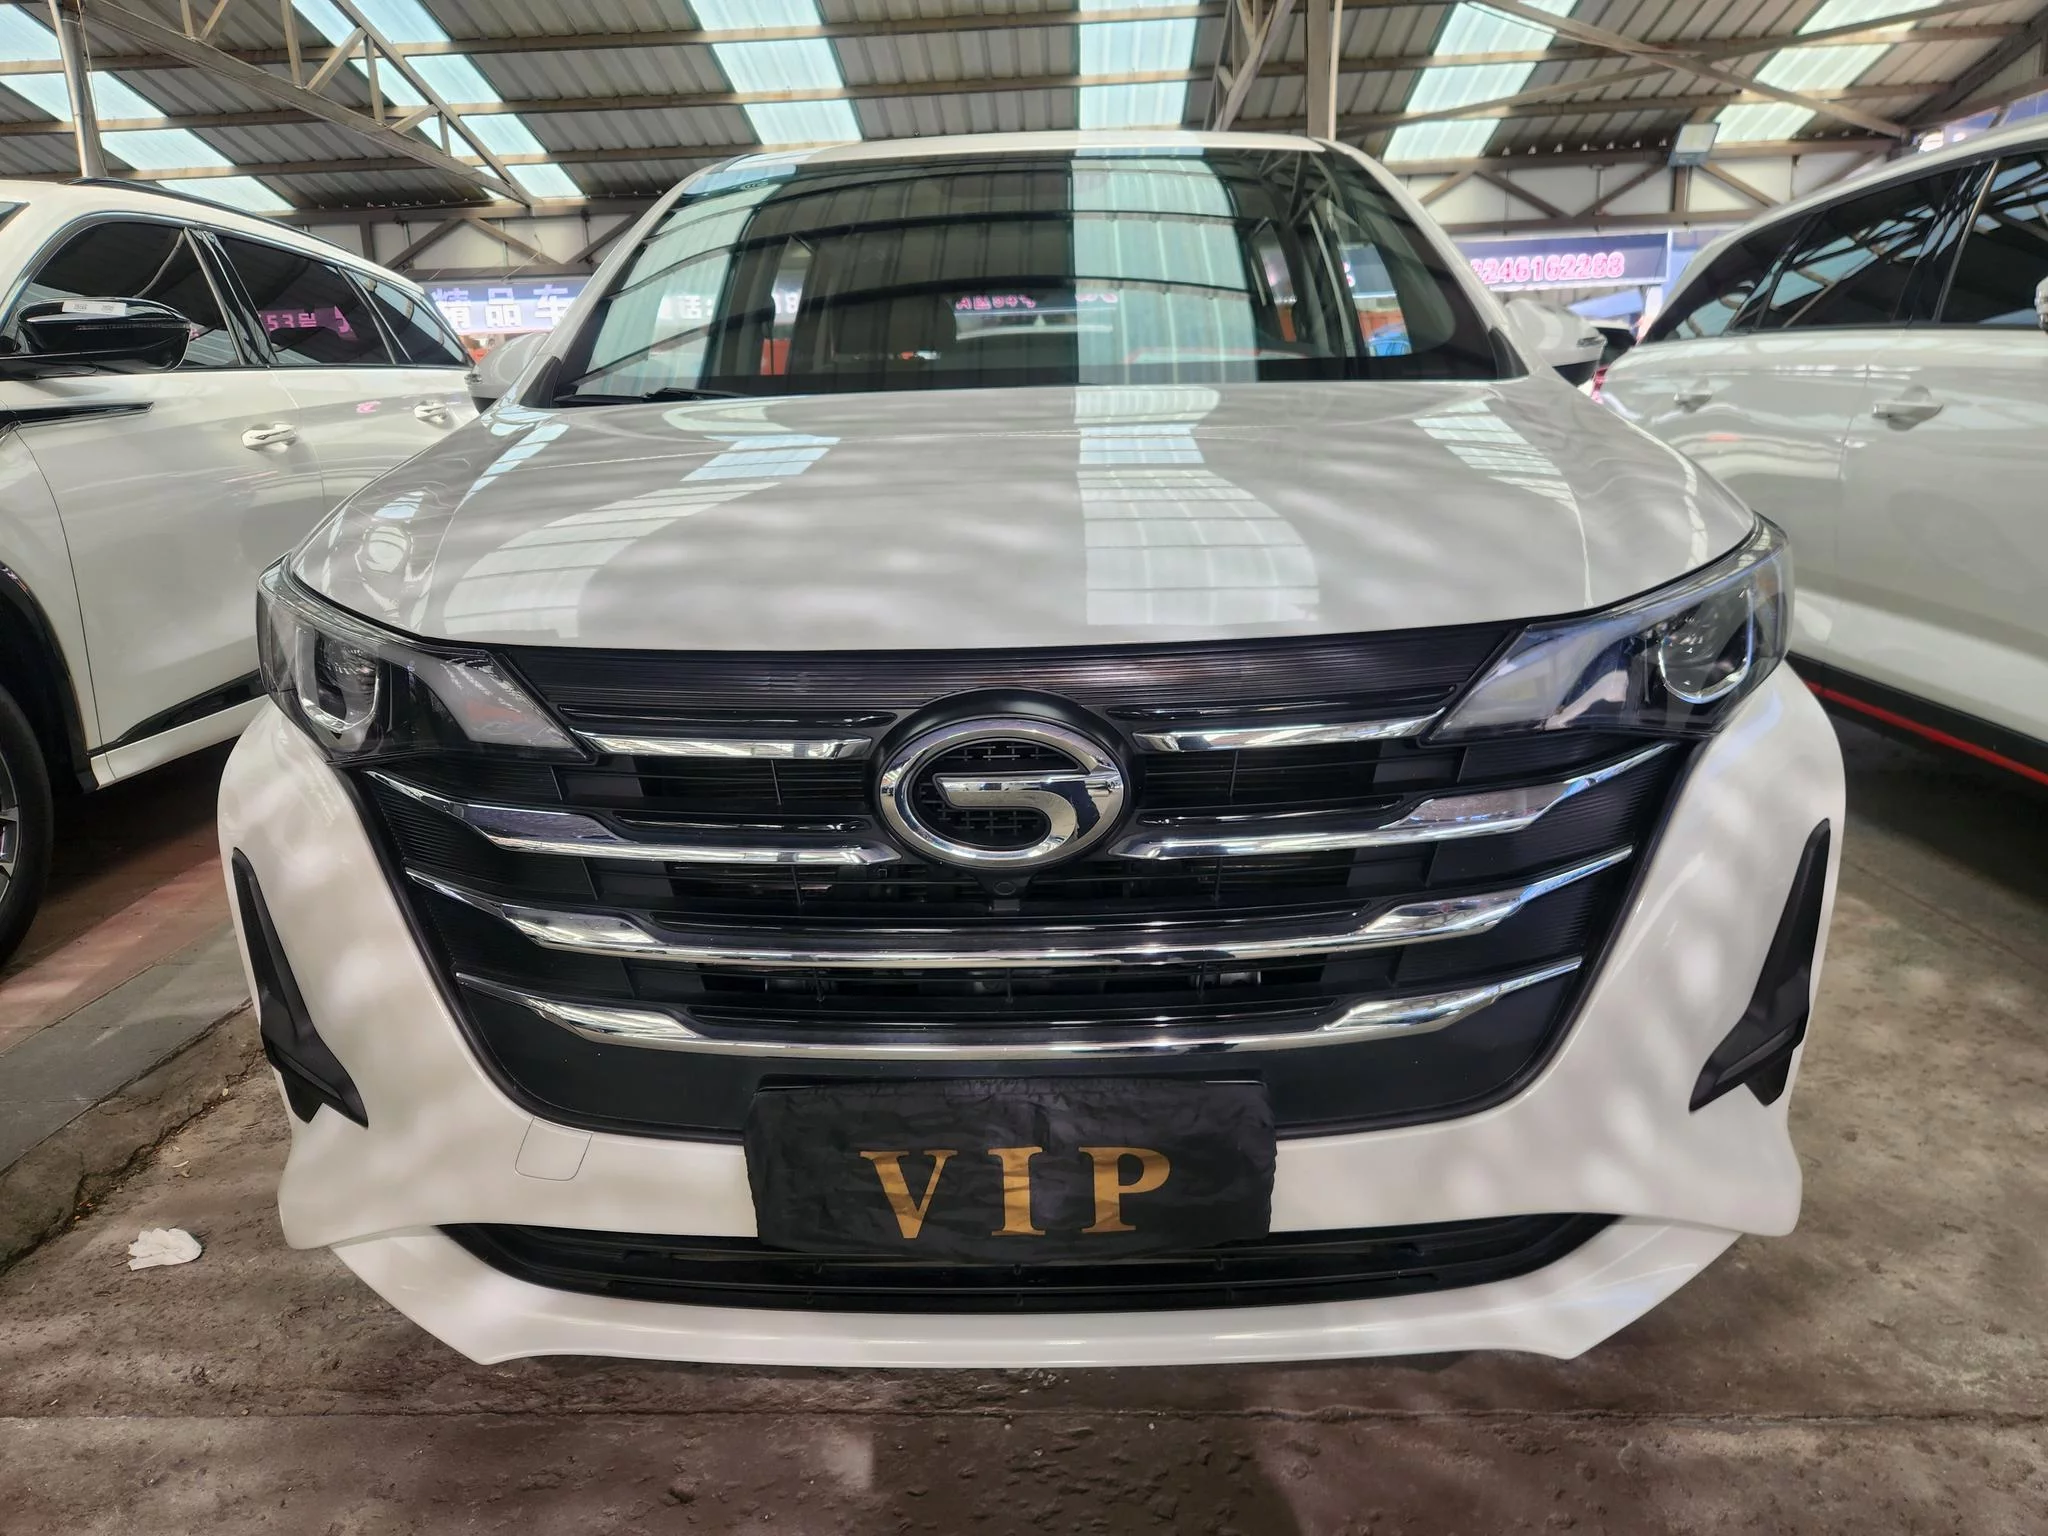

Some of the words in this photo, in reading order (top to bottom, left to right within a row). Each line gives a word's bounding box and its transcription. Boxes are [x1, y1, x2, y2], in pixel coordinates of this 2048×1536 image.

[431, 284, 569, 330] 精品车
[859, 1146, 1171, 1239] VIP
